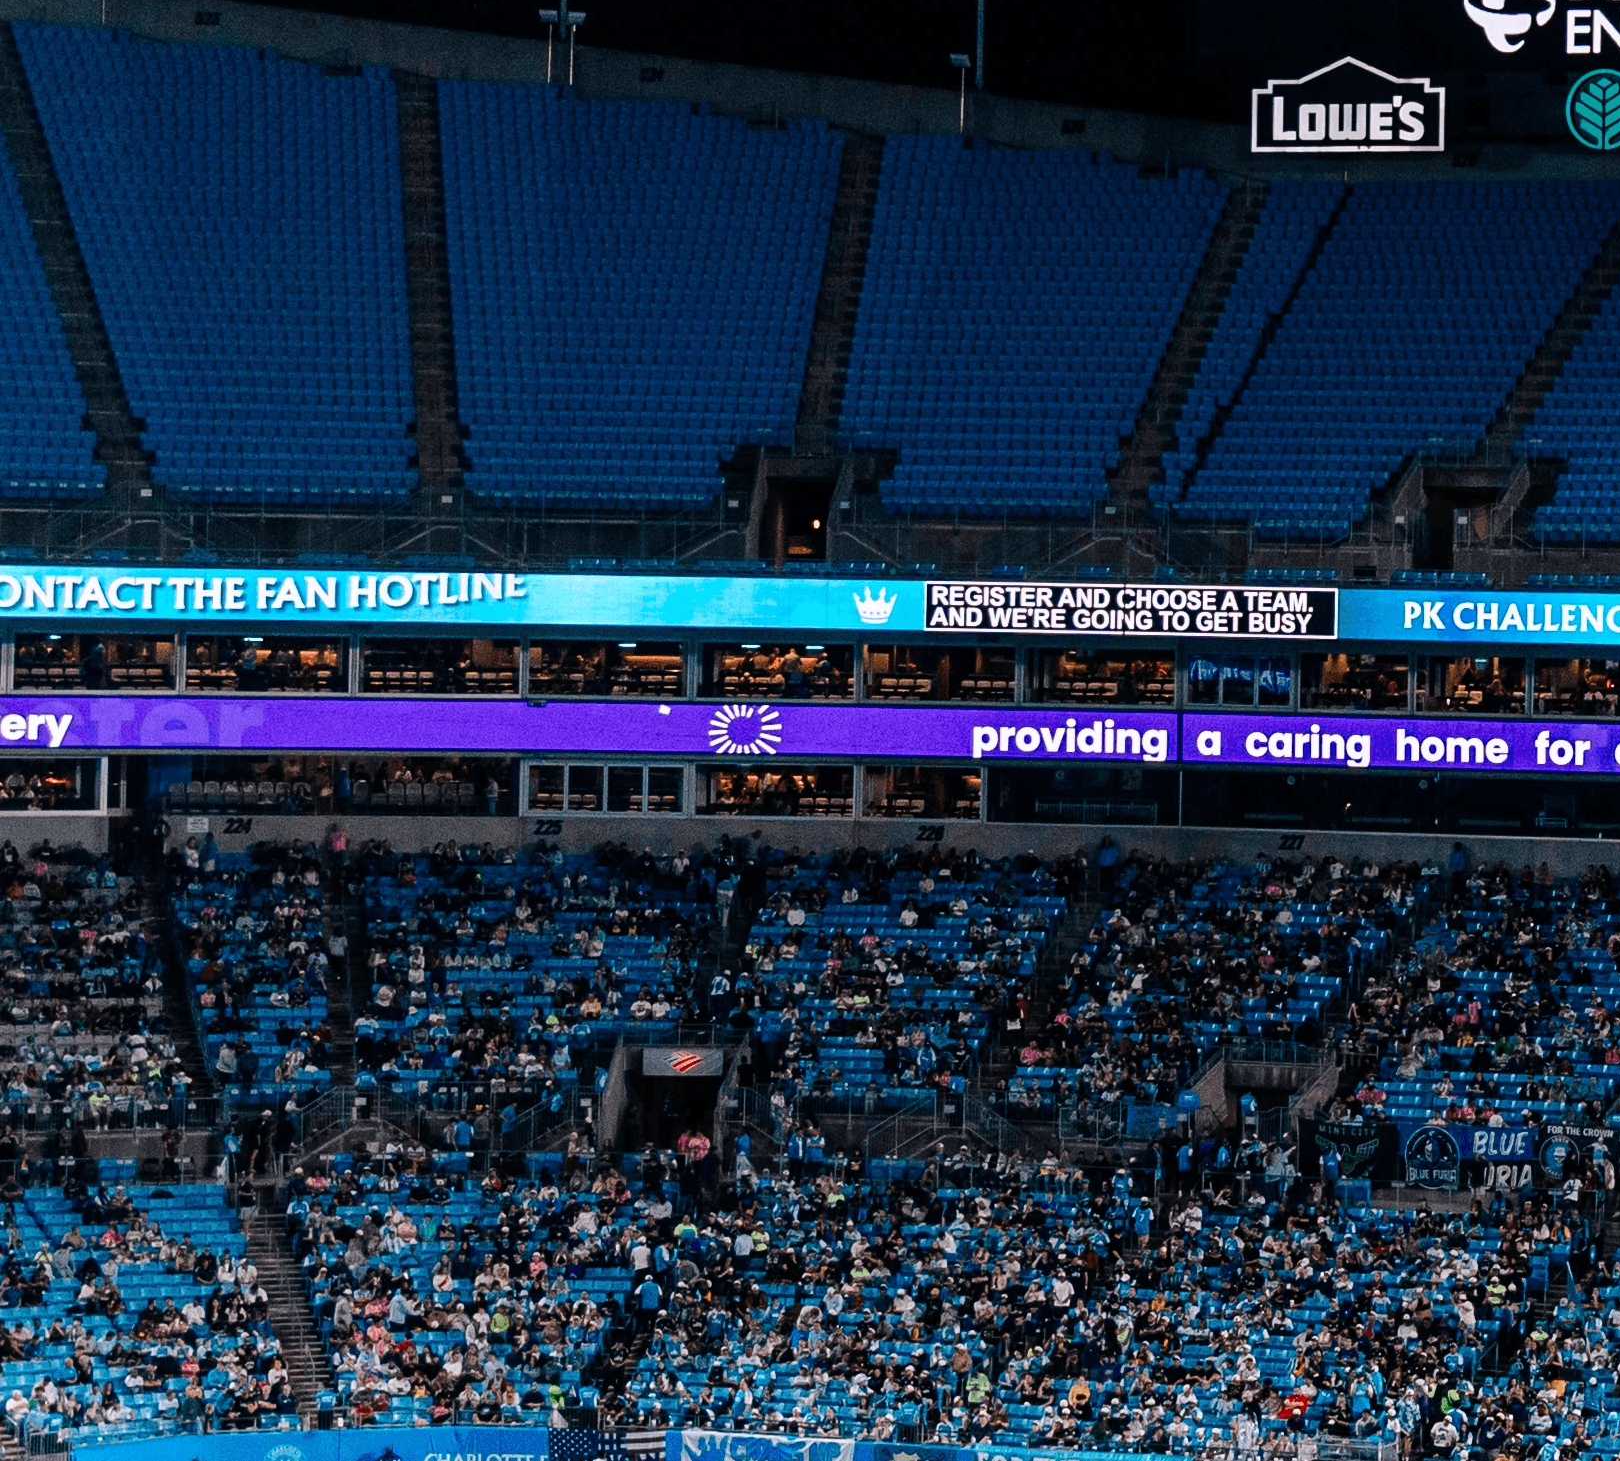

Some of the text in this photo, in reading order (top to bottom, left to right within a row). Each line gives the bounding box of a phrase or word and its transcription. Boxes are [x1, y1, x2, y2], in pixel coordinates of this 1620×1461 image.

[1272, 95, 1426, 140] LOWE'S
[168, 578, 245, 609] THE
[257, 577, 336, 608] FAN
[349, 573, 526, 607] HOTLINE
[932, 585, 1316, 615] REGISTER AND CHOOSE A TEAM.
[928, 608, 1313, 637] AND WE'RE GOING TO GET BUSY
[1405, 602, 1445, 629] PK
[973, 718, 1167, 761] providing
[1197, 731, 1221, 755] a
[1246, 724, 1370, 767] caring
[1397, 729, 1508, 763] home
[1535, 731, 1590, 765] for
[223, 818, 252, 834] 224
[534, 819, 563, 835] 225
[1473, 1131, 1529, 1156] BLUE
[1547, 1125, 1614, 1138] FOR THE CROWN
[1409, 1166, 1430, 1182] BLUE
